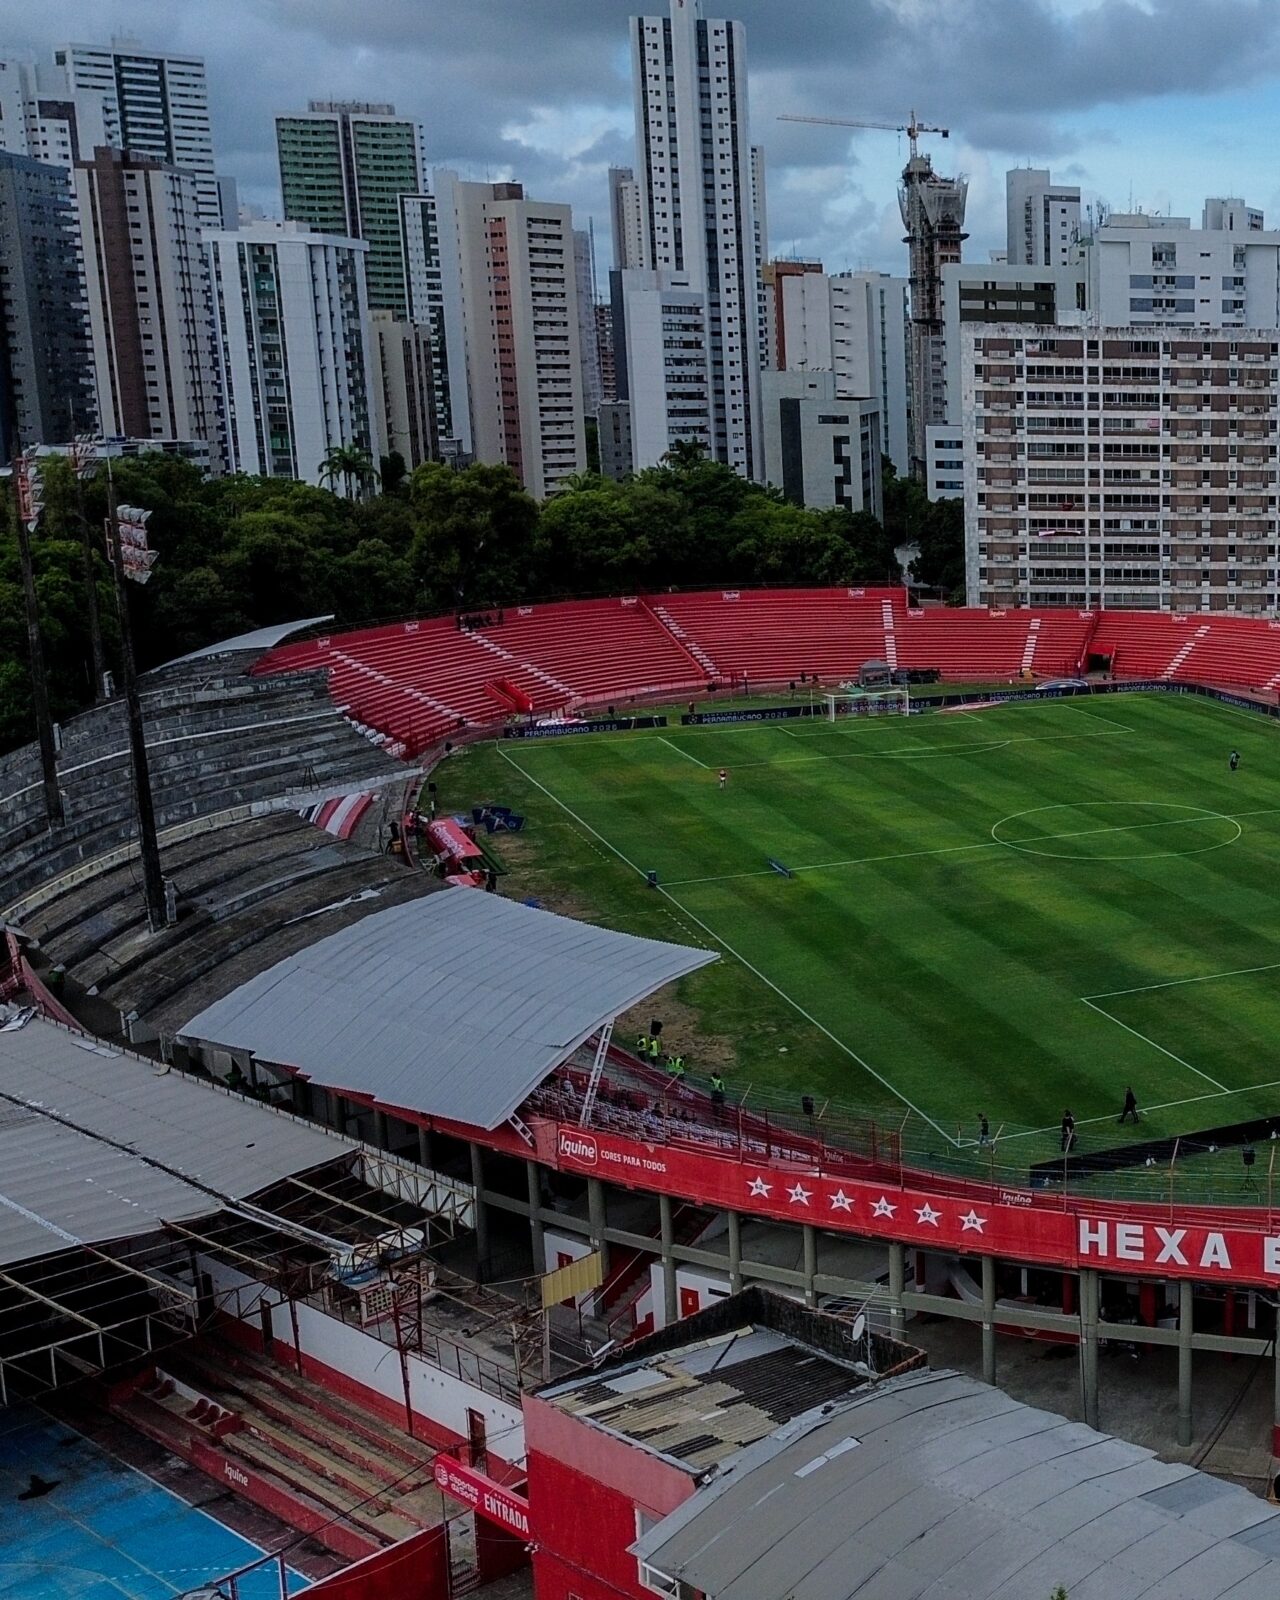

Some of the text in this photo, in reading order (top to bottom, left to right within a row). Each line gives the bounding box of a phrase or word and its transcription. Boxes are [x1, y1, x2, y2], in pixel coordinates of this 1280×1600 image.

[703, 714, 762, 723] PERNAMBUCANO
[560, 1135, 666, 1172] Iquine CORES PARA TODOS
[794, 1190, 804, 1198] 64
[1079, 1219, 1232, 1270] HEXA
[224, 1461, 249, 1487] Iquine
[483, 1493, 529, 1534] ENTRADA
